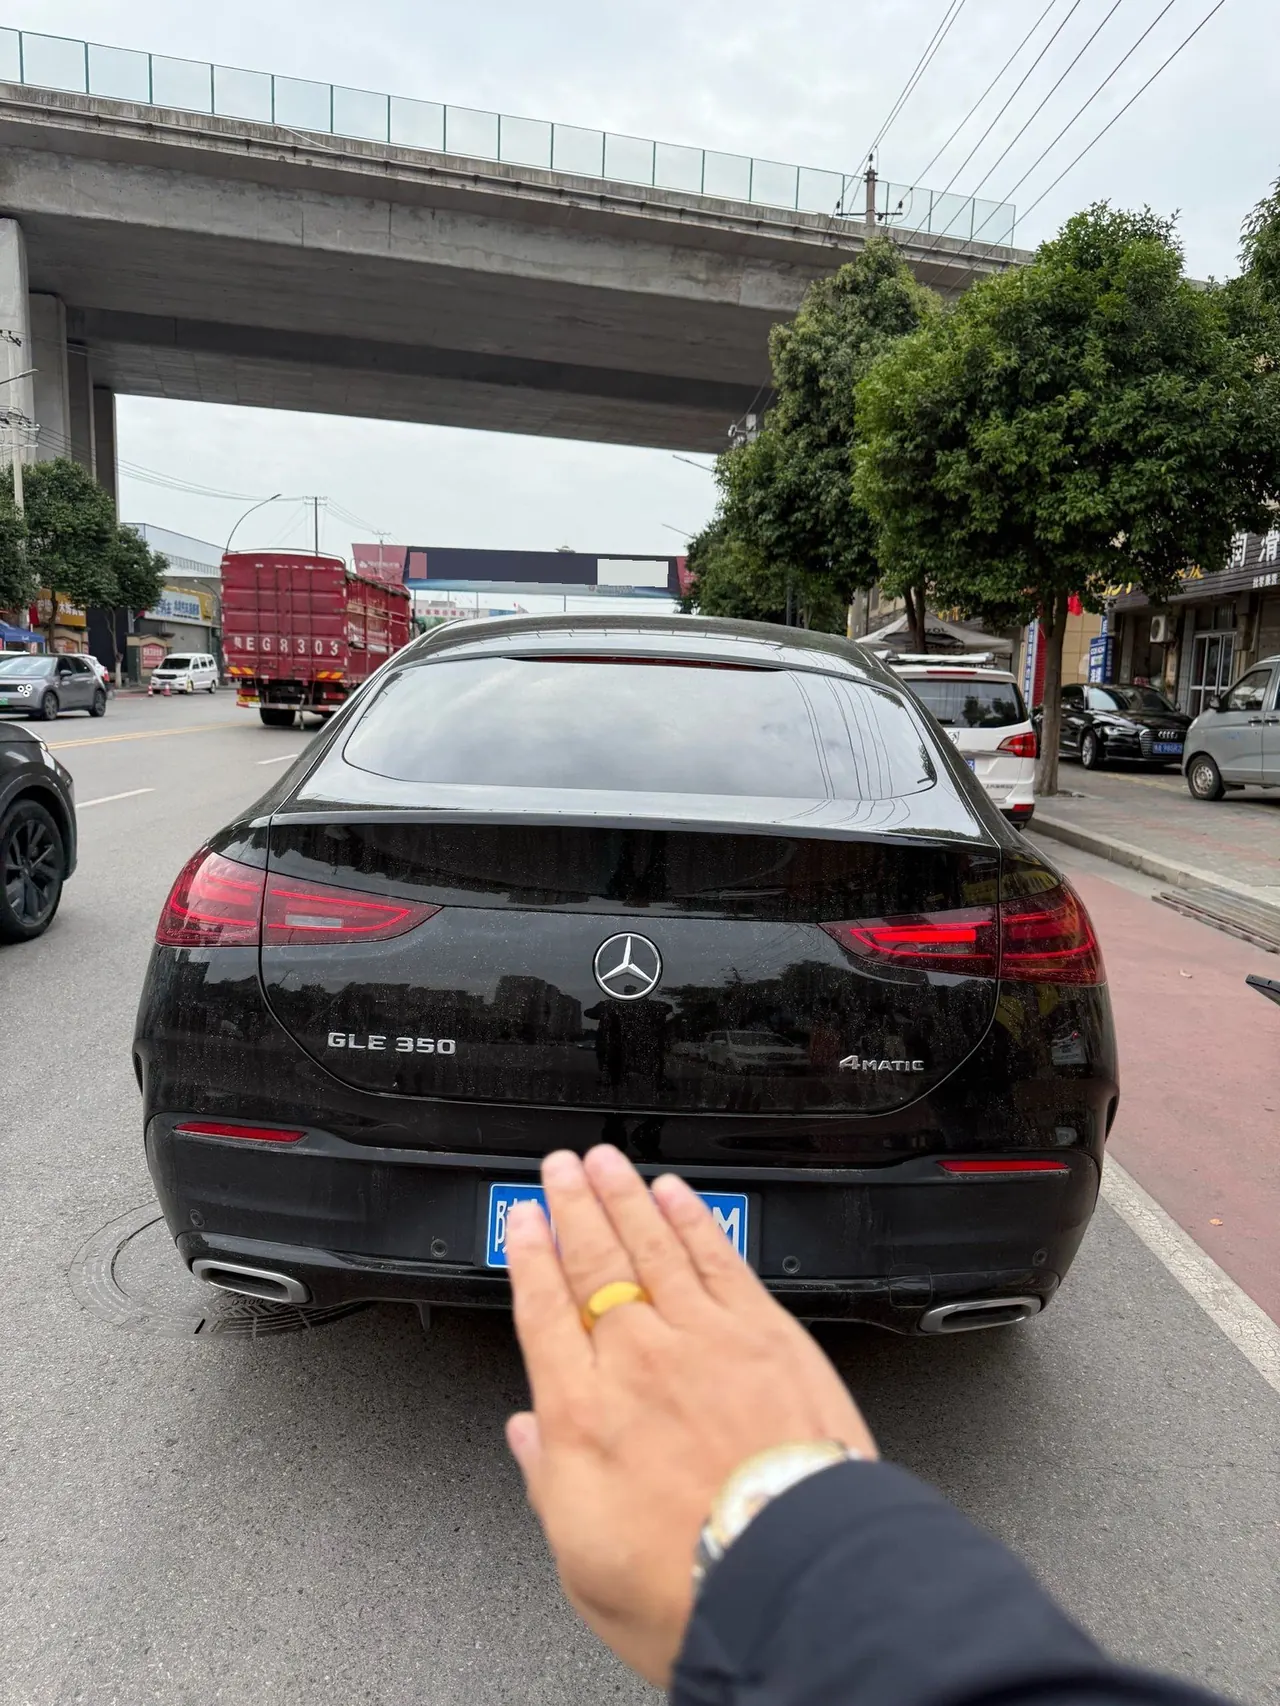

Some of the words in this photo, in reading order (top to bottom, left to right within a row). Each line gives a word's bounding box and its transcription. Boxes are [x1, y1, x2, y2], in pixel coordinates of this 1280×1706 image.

[327, 1032, 387, 1051] GLE
[395, 1036, 456, 1055] 350
[839, 1054, 925, 1072] 4MATIC
